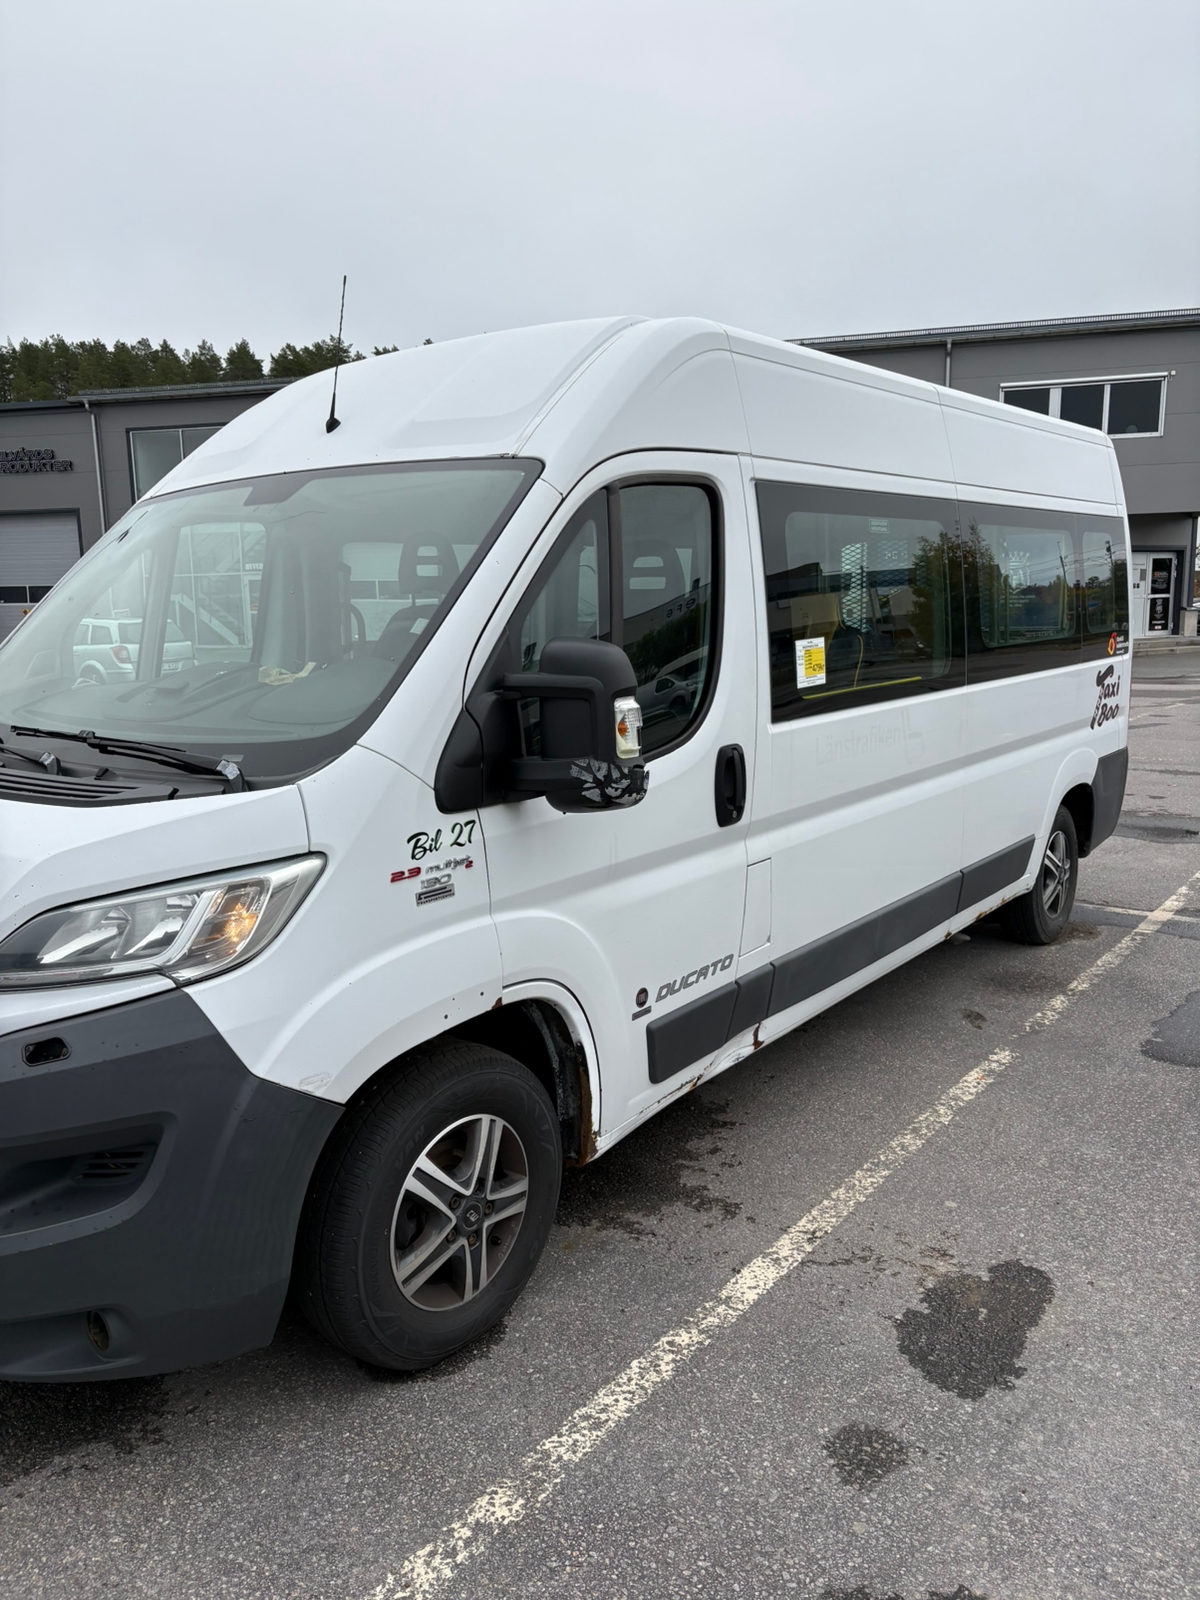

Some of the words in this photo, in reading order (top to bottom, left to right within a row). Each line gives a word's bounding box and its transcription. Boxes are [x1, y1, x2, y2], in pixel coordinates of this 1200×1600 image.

[0, 446, 54, 461] ILVÅRDS
[0, 459, 72, 473] RODUKTER
[1090, 664, 1121, 730] Taxi
[1097, 702, 1120, 728] 800
[815, 724, 901, 766] Länstrafiken
[406, 828, 443, 861] Bil
[449, 819, 476, 848] 27
[655, 953, 734, 1003] DUCATO
